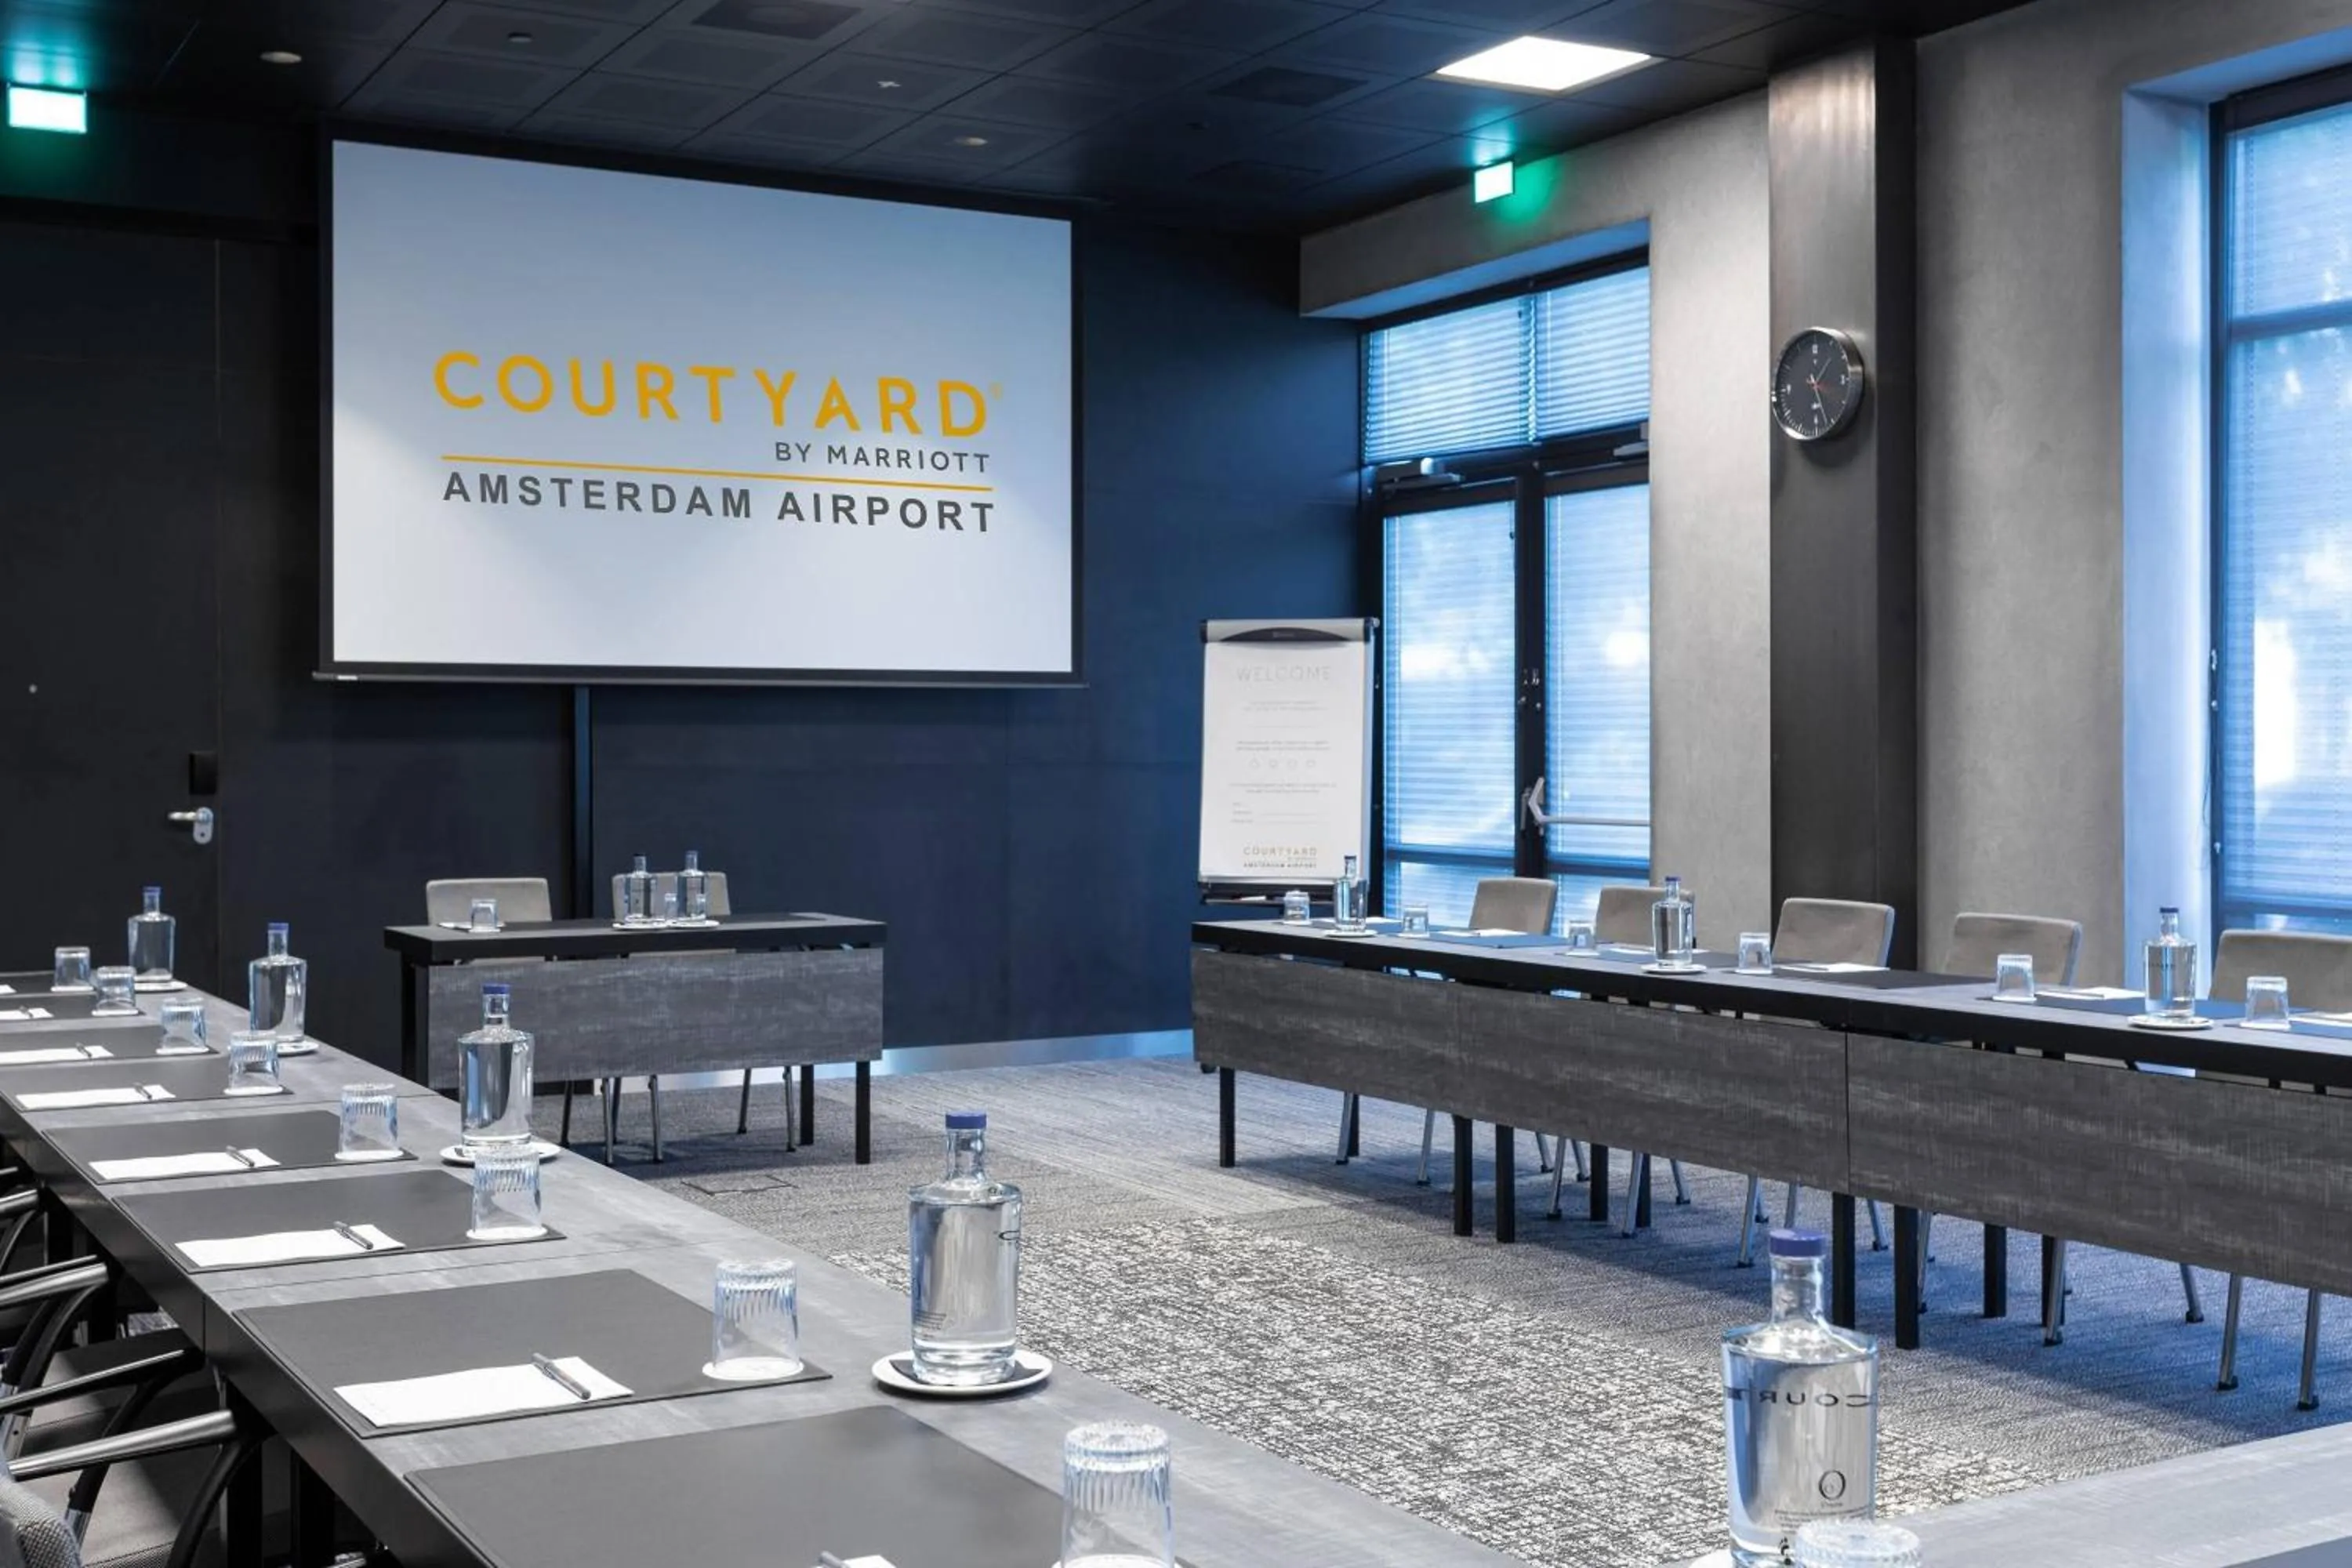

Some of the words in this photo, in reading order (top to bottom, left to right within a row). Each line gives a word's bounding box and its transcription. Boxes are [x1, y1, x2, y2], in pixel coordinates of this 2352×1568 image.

[433, 350, 988, 438] COURTYARD
[775, 441, 811, 463] BY
[827, 445, 989, 473] MARRIOTT
[443, 471, 751, 518] AMSTERDAM
[777, 492, 994, 532] AIRPORT
[1236, 665, 1331, 681] WELCOME
